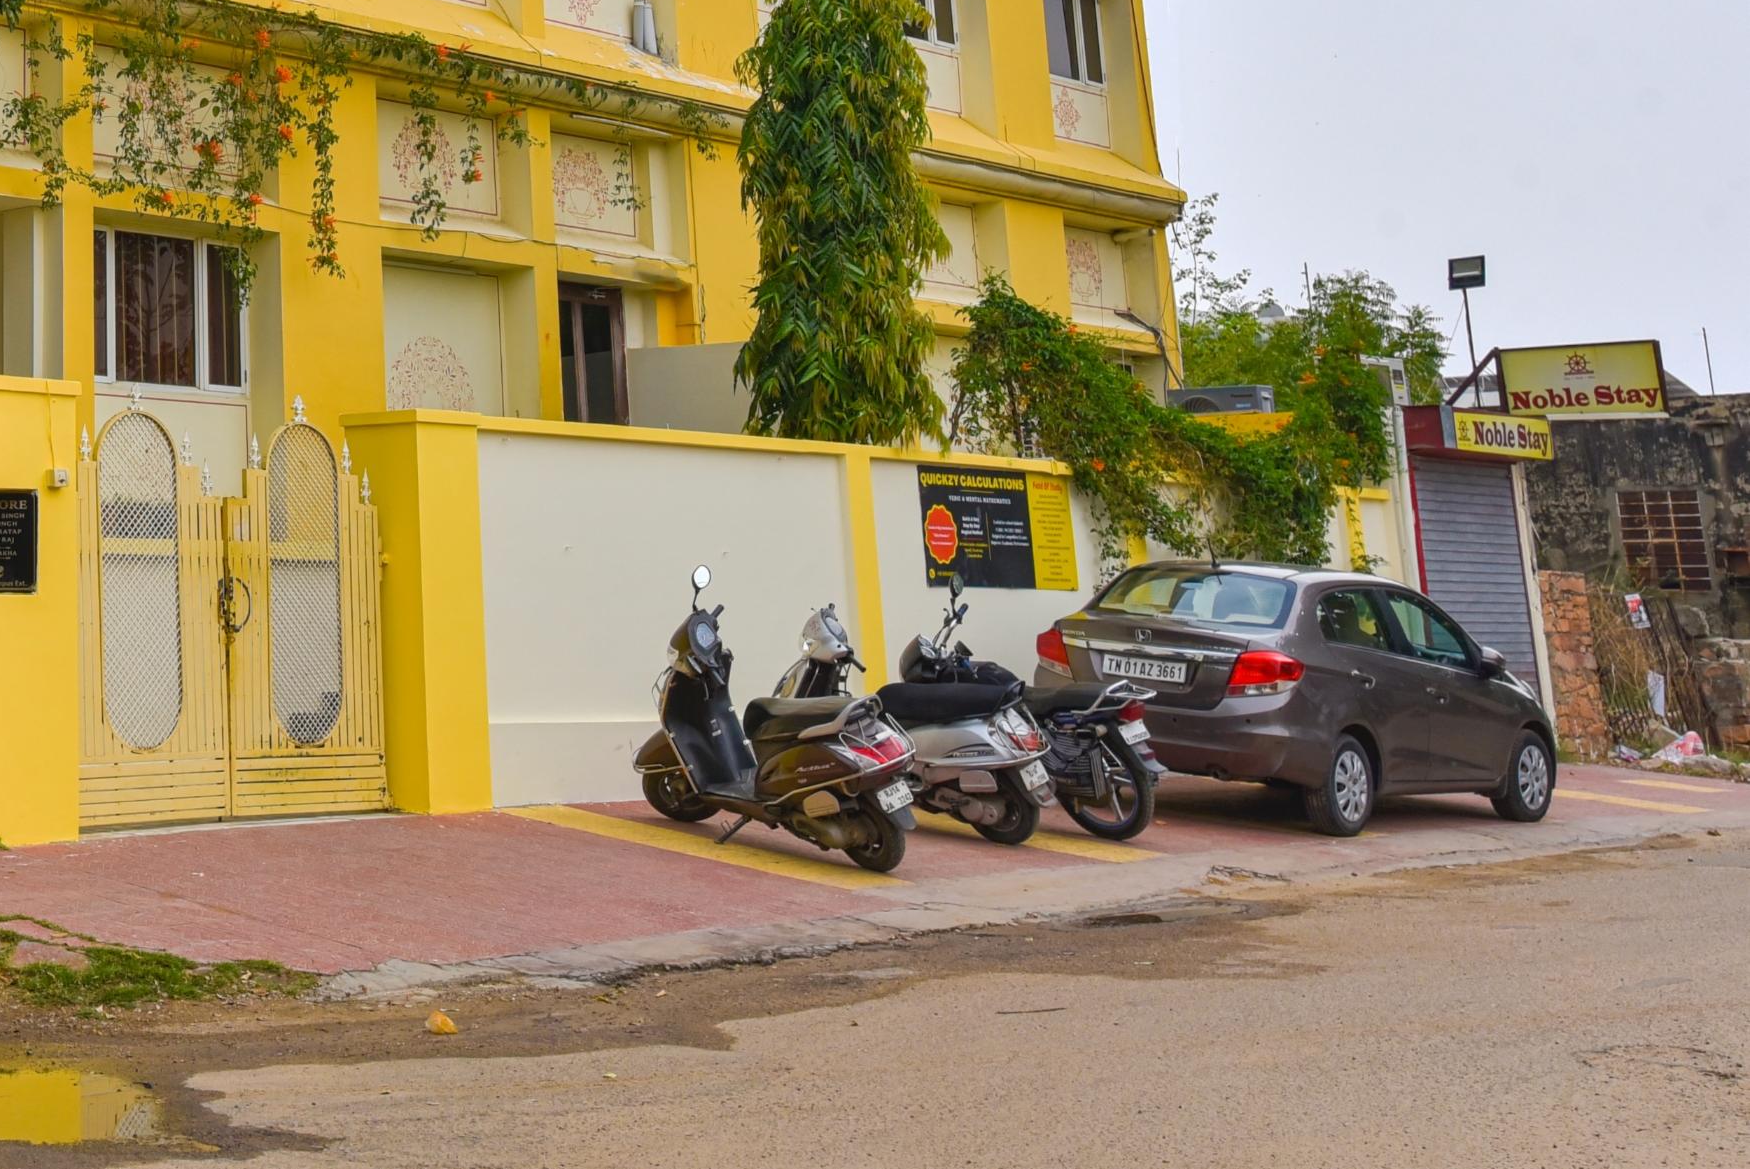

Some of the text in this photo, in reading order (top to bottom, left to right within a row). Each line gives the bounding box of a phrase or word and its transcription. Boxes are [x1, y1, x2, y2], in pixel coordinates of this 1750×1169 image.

[1509, 385, 1660, 411] Noble Stay
[1472, 420, 1549, 457] Noble Stay
[920, 471, 1025, 491] QUICKZY CALCULATIONS
[1108, 658, 1182, 679] TN 01 AZ 3661
